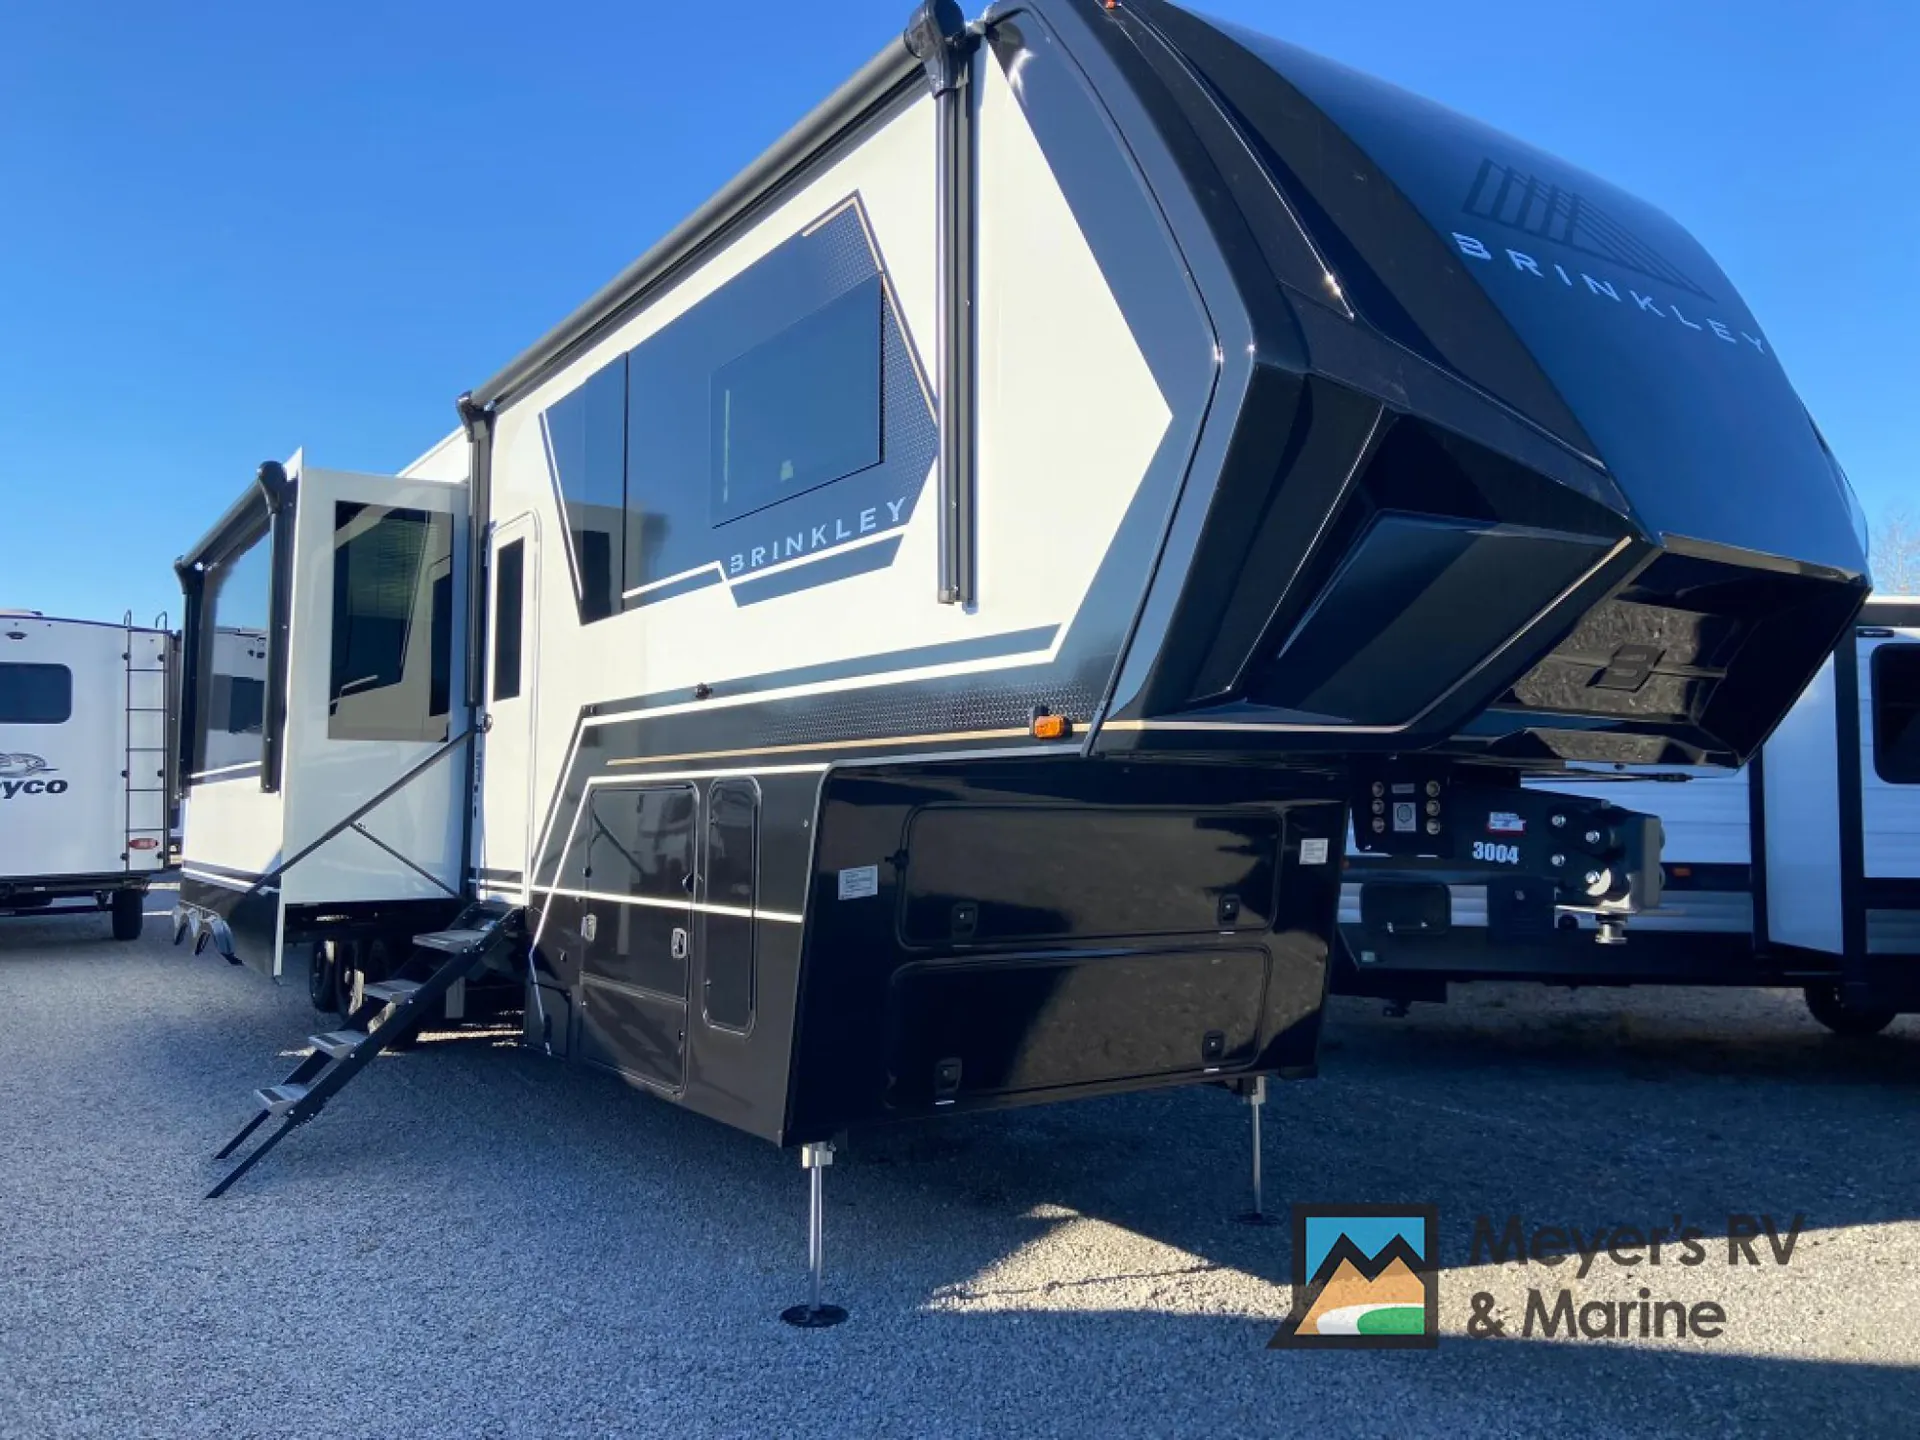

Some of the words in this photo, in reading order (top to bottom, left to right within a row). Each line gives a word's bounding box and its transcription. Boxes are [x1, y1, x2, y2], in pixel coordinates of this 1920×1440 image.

[1451, 231, 1766, 355] BRINKLEY
[729, 496, 907, 574] BRINKLEY
[0, 779, 69, 800] yco
[1472, 841, 1519, 864] 3004
